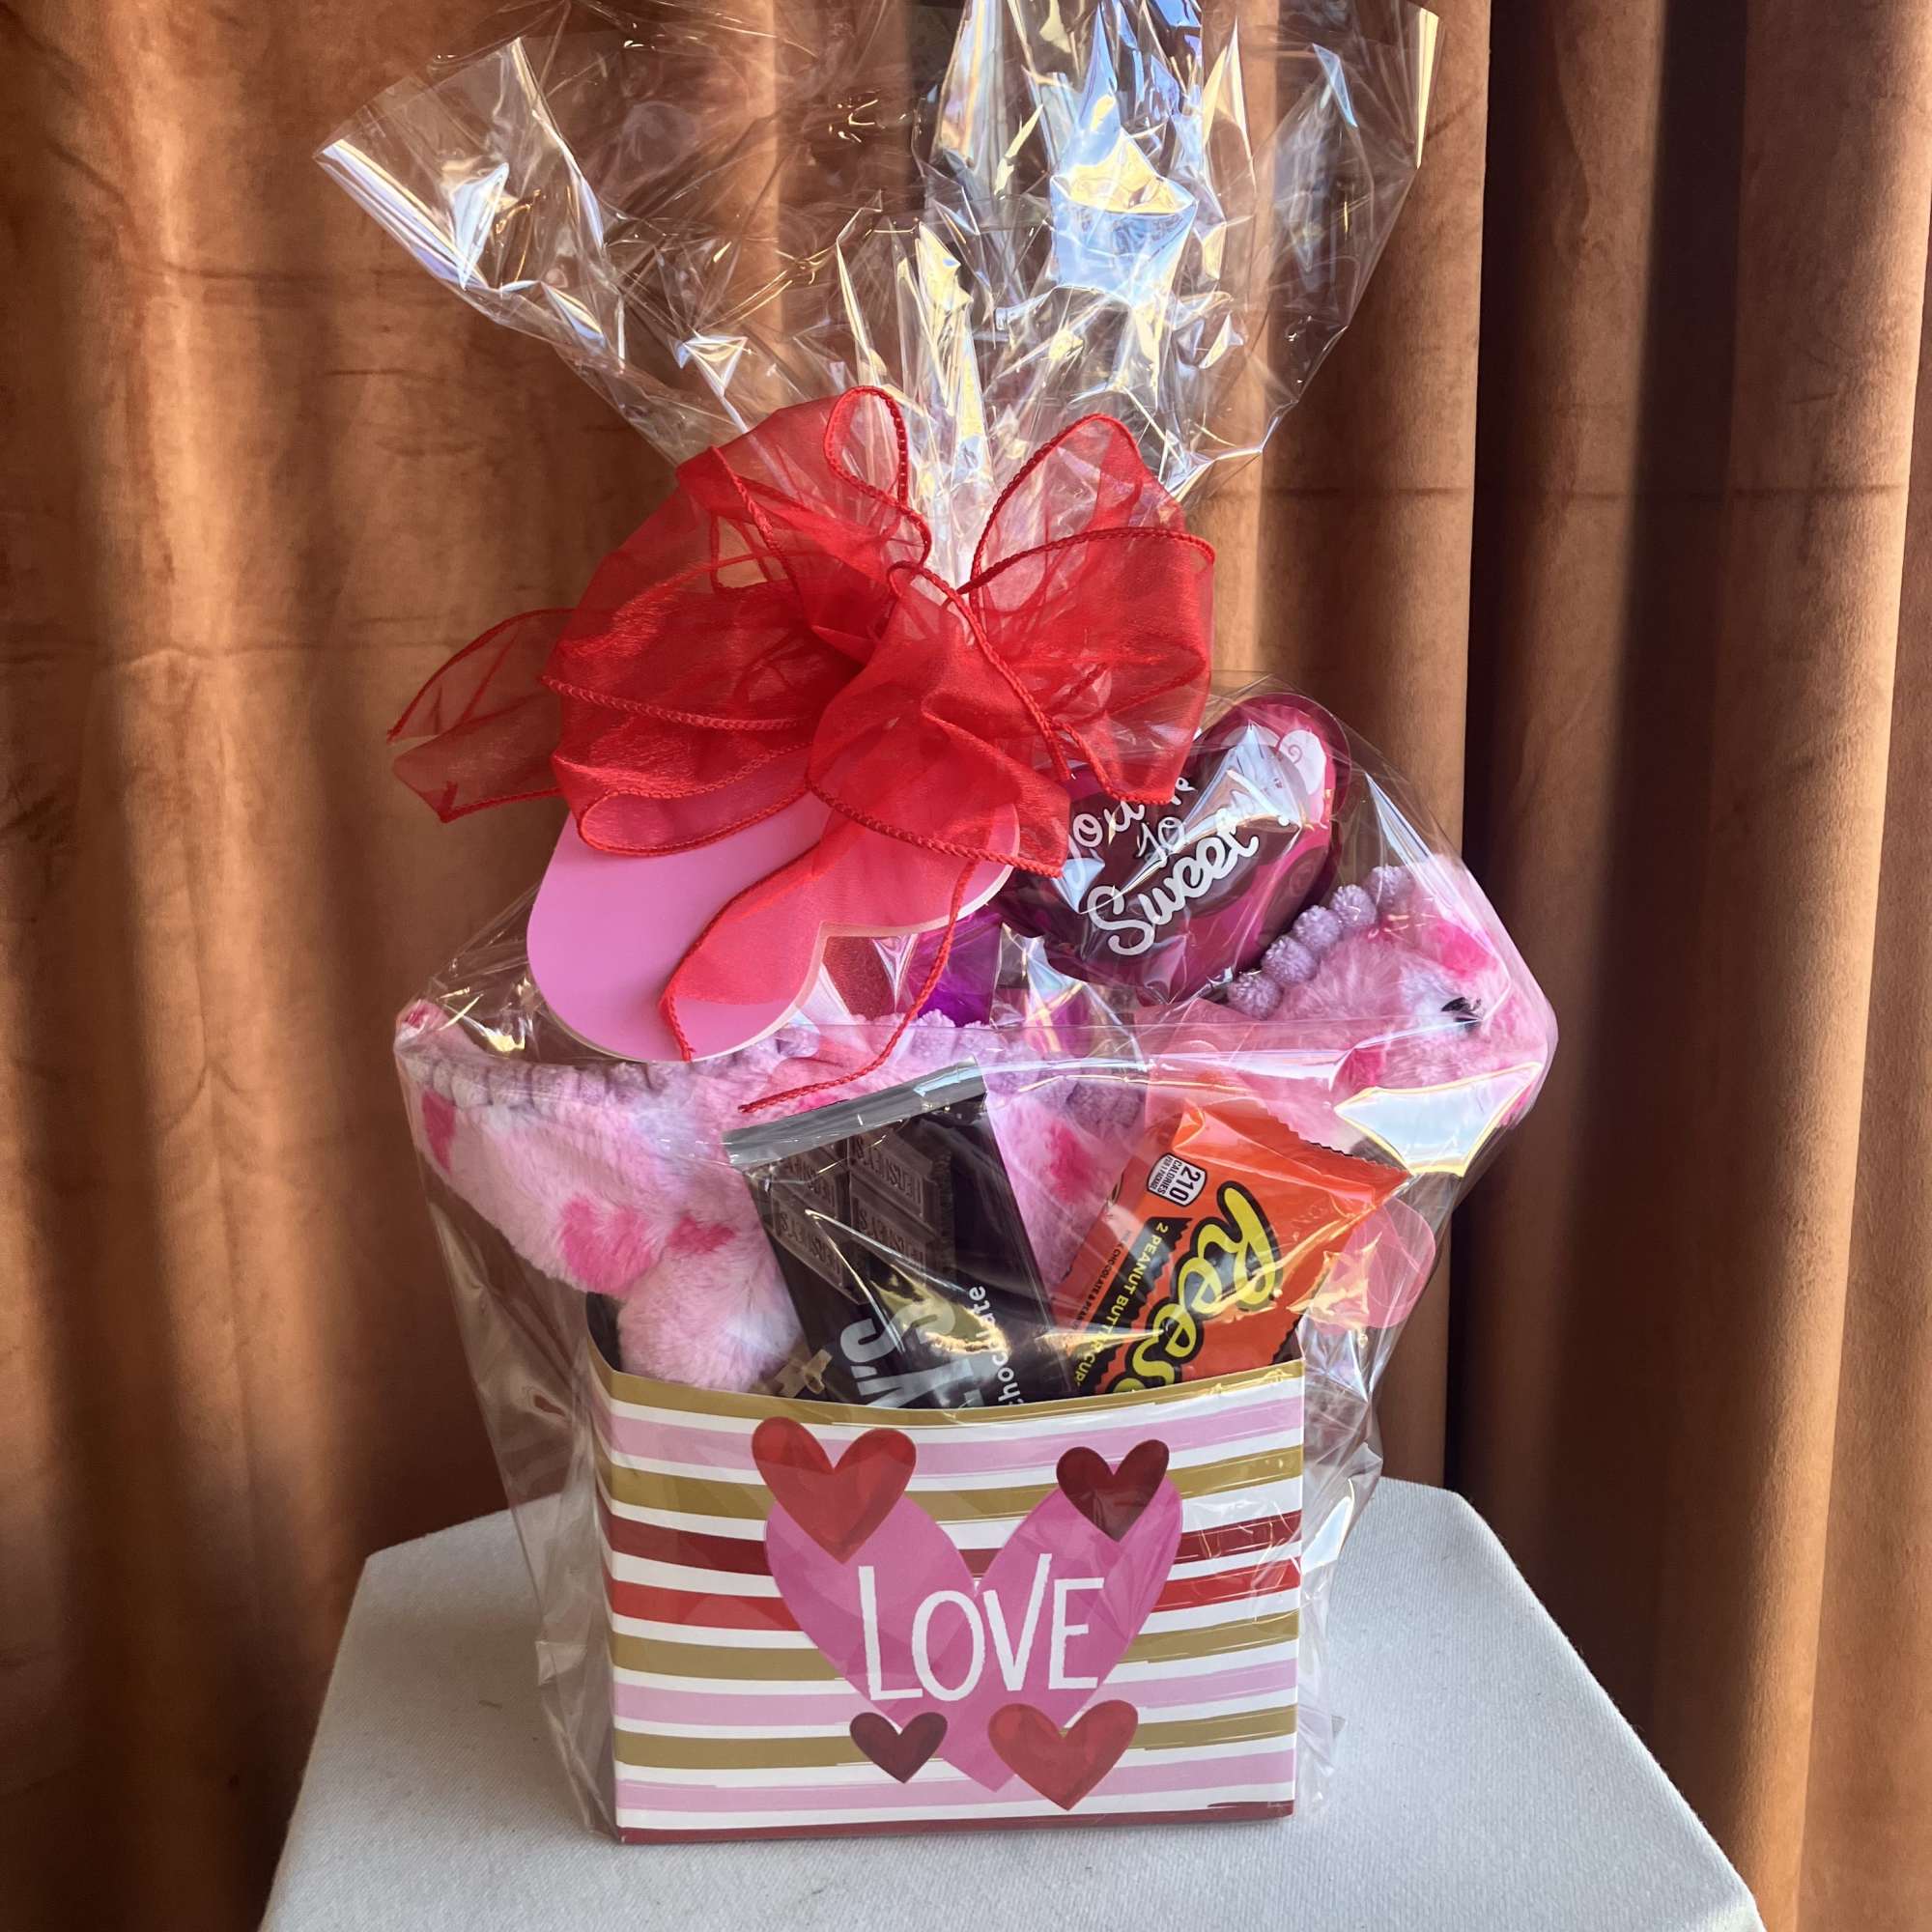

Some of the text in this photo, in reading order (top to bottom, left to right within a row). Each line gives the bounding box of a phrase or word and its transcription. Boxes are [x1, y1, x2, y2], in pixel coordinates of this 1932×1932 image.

[1157, 1160, 1182, 1194] CALORIES
[1169, 1166, 1201, 1201] 210
[1155, 1222, 1169, 1234] 2
[1113, 1184, 1278, 1393] Rees
[1123, 1234, 1162, 1294] PEANUT
[1091, 1294, 1129, 1352] BUTTR
[858, 1552, 1104, 1701] LOVE
